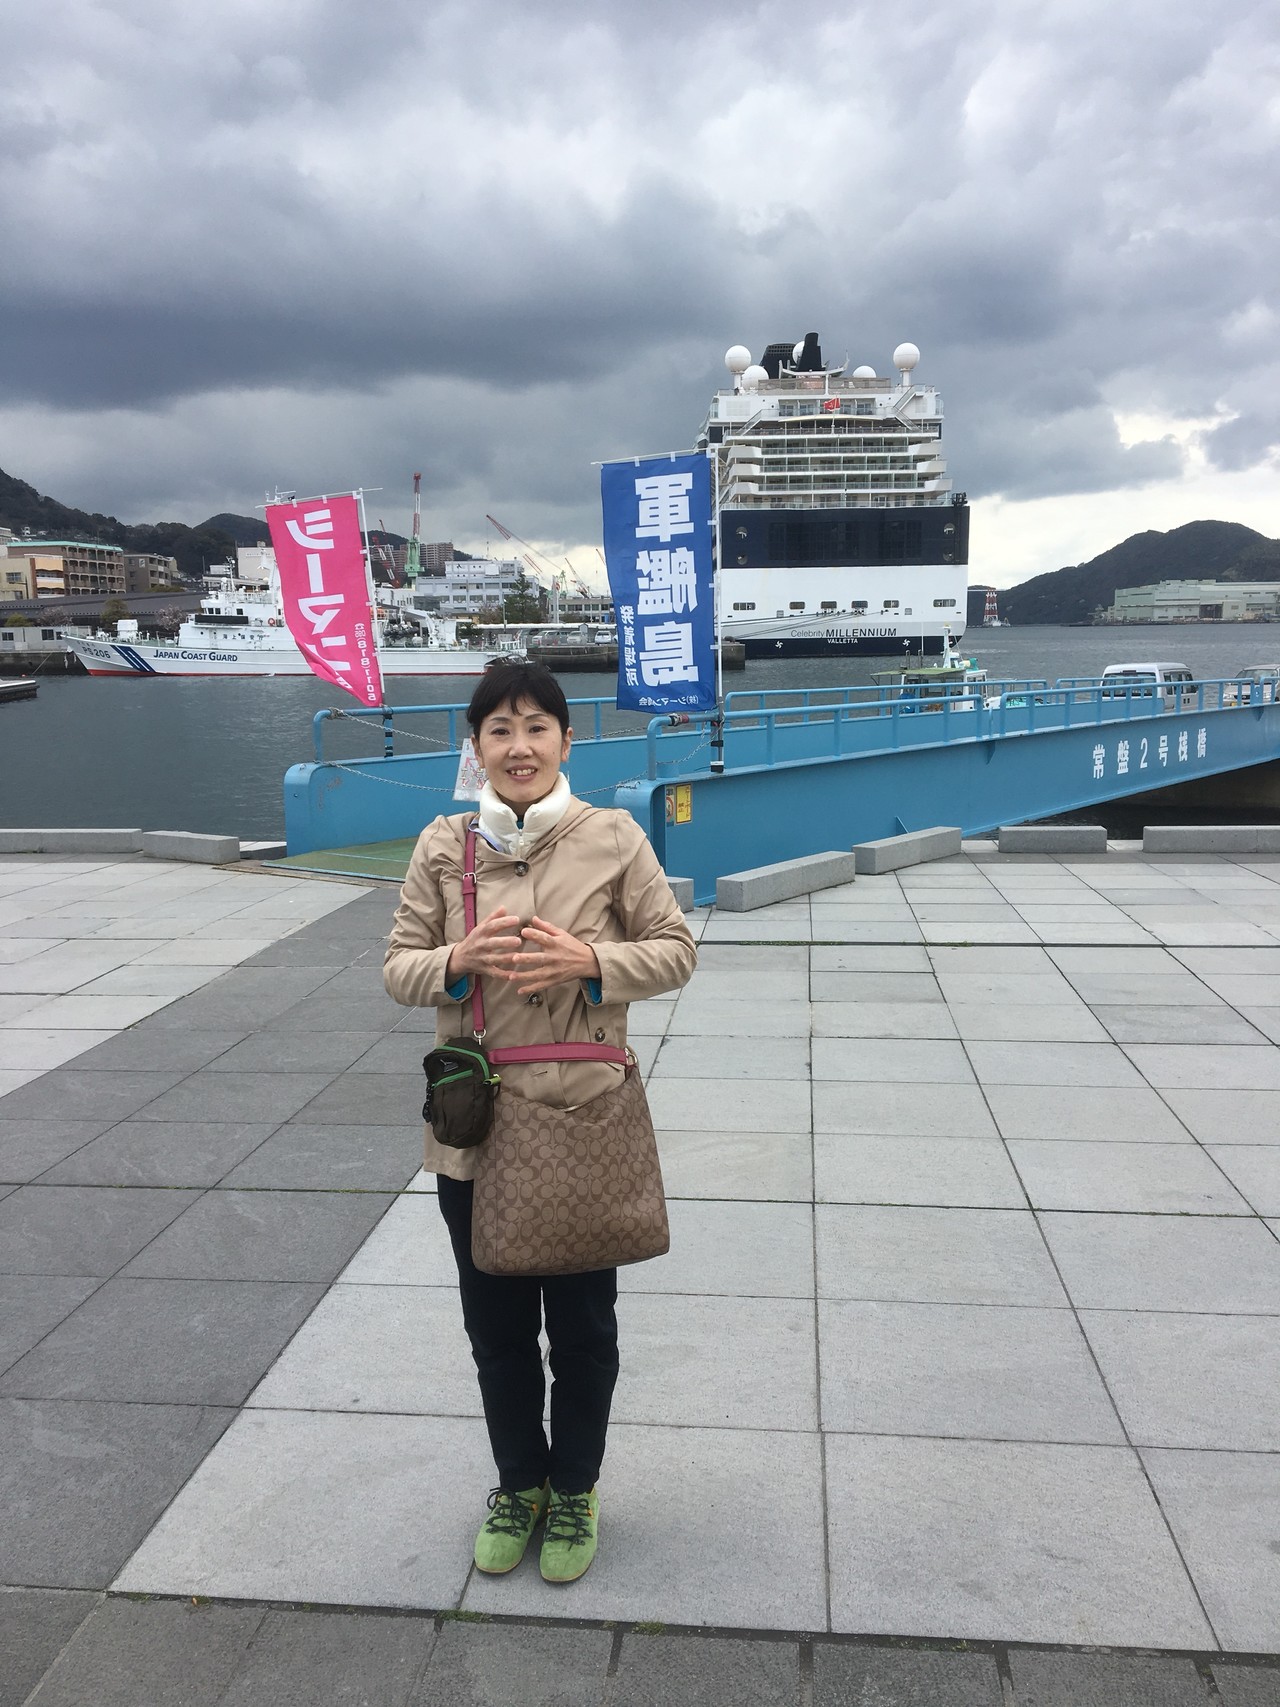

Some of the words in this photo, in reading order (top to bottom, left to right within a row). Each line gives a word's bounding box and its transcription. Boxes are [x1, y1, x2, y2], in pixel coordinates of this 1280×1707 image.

[790, 629, 825, 639] Celebrity
[825, 628, 897, 638] MILLENNIUM
[153, 649, 179, 659] JAPAN
[181, 651, 207, 661] COAST
[209, 652, 238, 662] GUARD
[1091, 727, 1207, 780] 常盤2号桟橋
